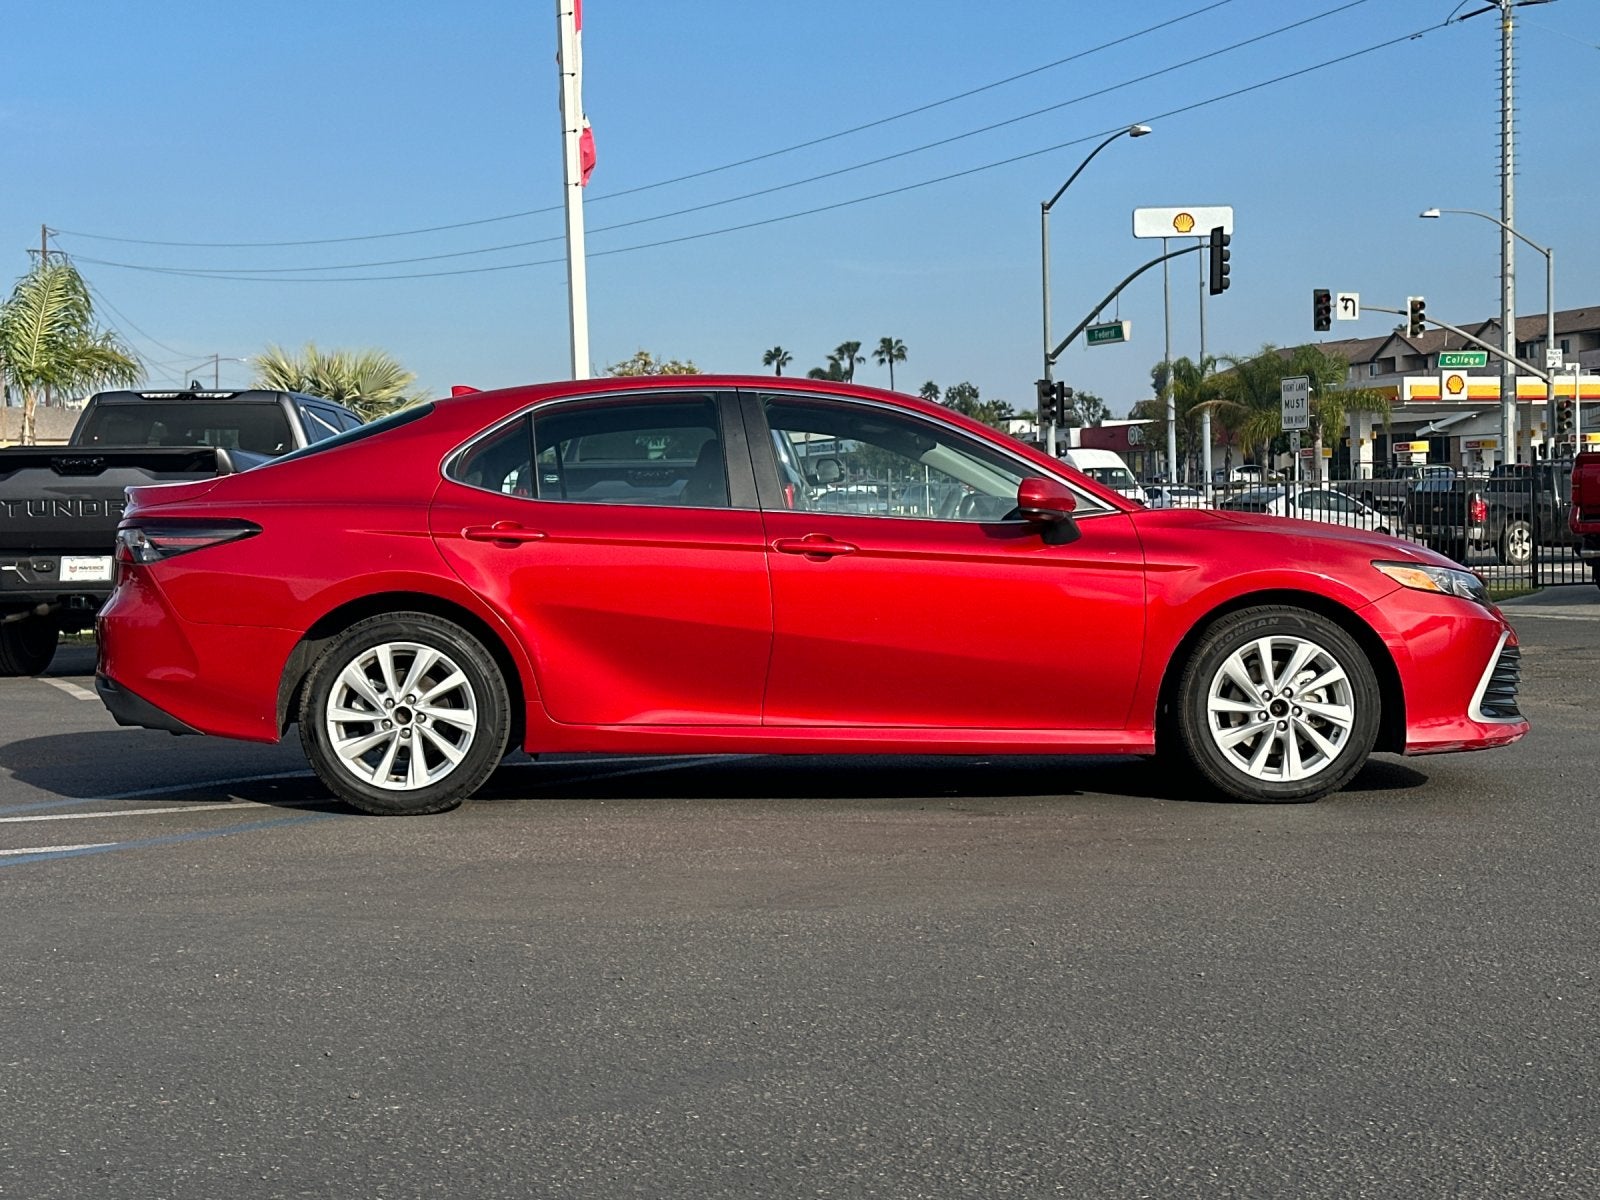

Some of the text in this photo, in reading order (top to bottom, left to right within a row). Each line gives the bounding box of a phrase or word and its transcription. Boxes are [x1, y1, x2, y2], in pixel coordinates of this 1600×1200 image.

[1094, 328, 1115, 340] Federal
[1445, 356, 1480, 366] College
[1296, 383, 1306, 391] LANE
[1285, 398, 1304, 409] MUST
[0, 500, 126, 517] TUNDR
[1213, 617, 1279, 655] IRONMAN
